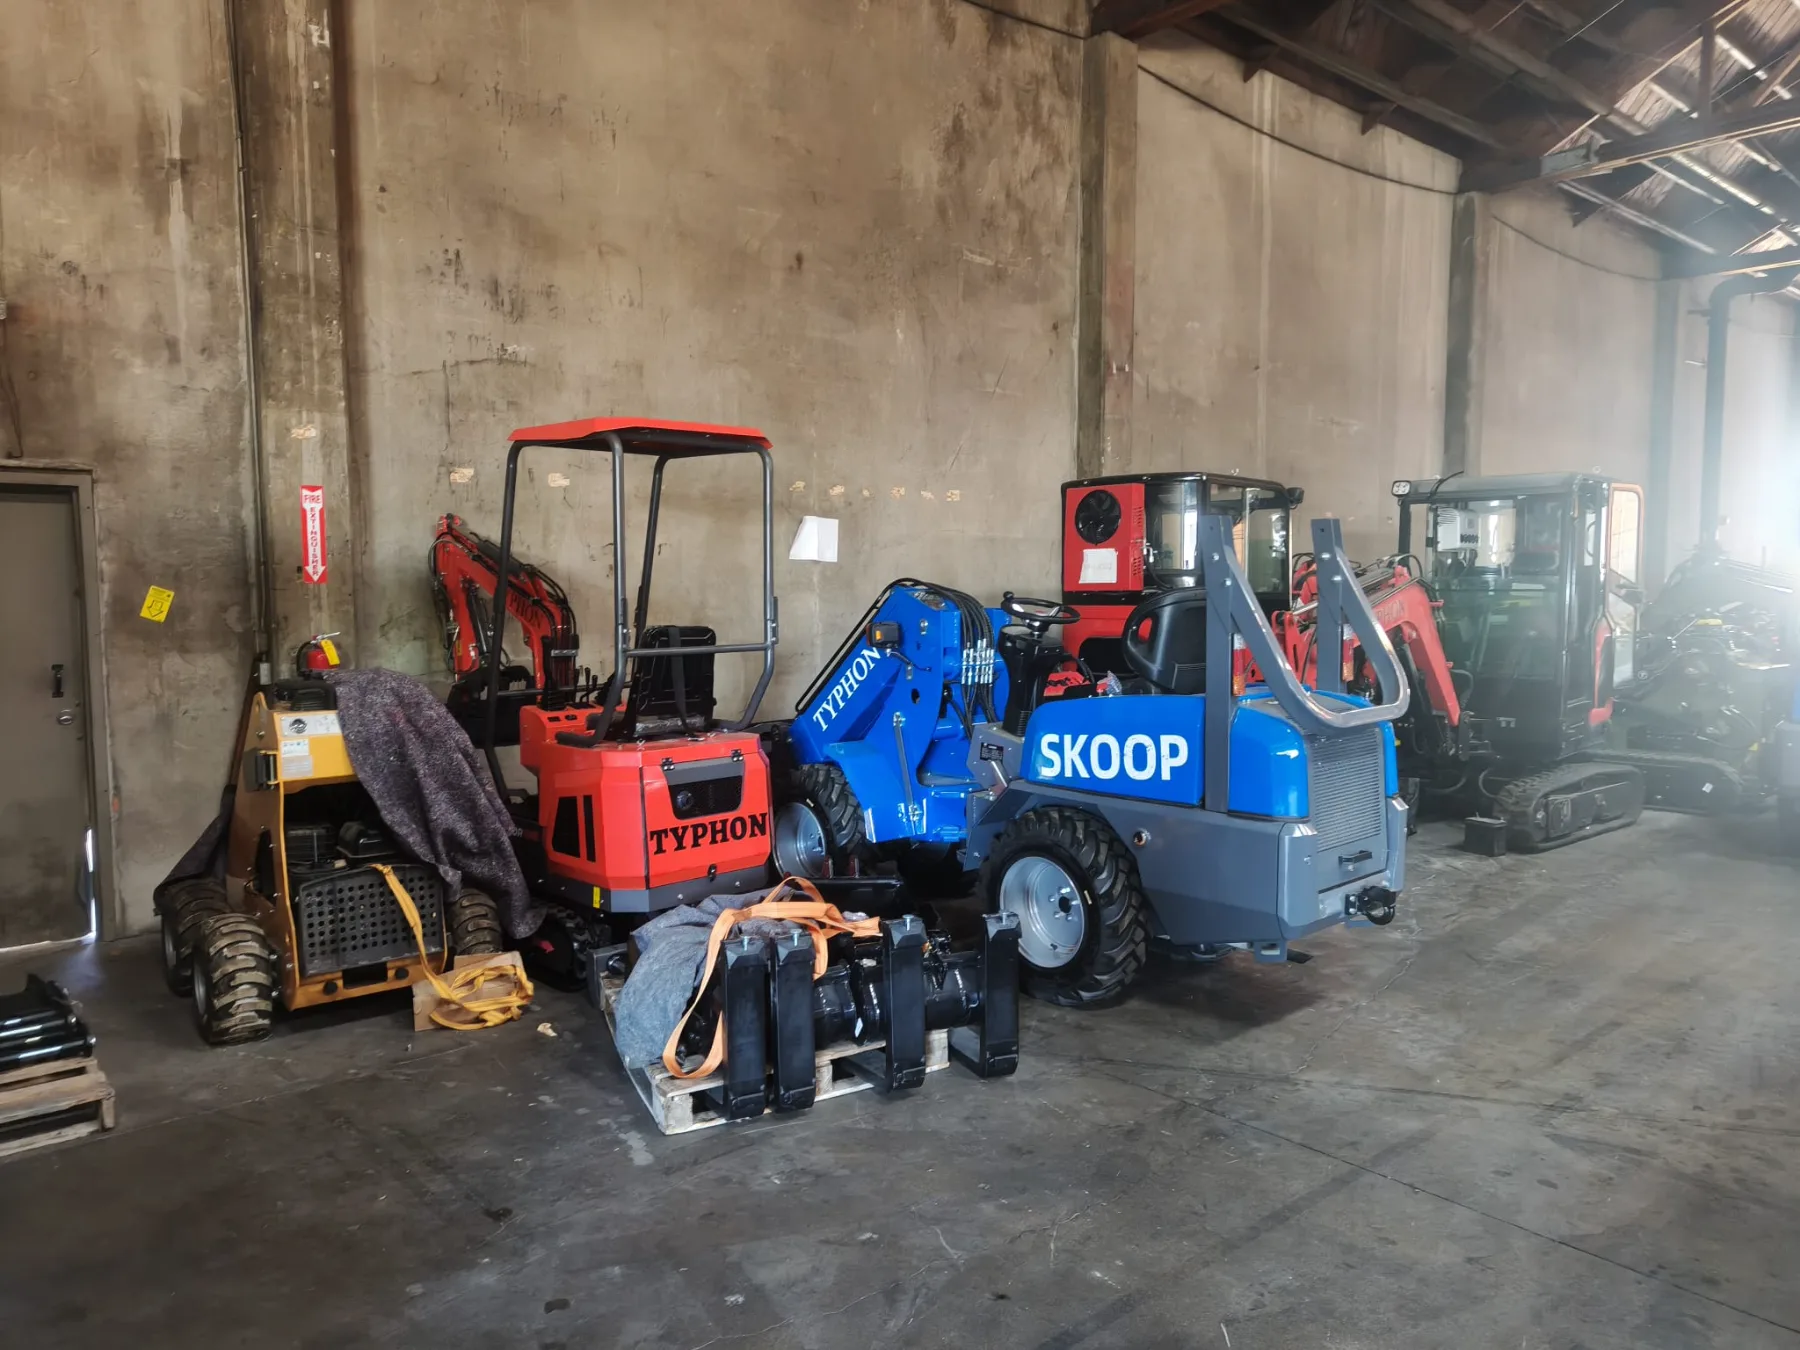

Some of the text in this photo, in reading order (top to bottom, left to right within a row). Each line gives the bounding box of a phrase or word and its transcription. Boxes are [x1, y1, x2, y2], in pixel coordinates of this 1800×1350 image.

[303, 494, 321, 504] FIRE
[310, 507, 319, 576] EXTINGUISHER
[508, 592, 543, 629] PHON
[1377, 600, 1405, 626] PHON
[812, 647, 882, 732] TYPHON
[1040, 733, 1189, 781] SKOOP
[649, 812, 768, 855] TYPHON
